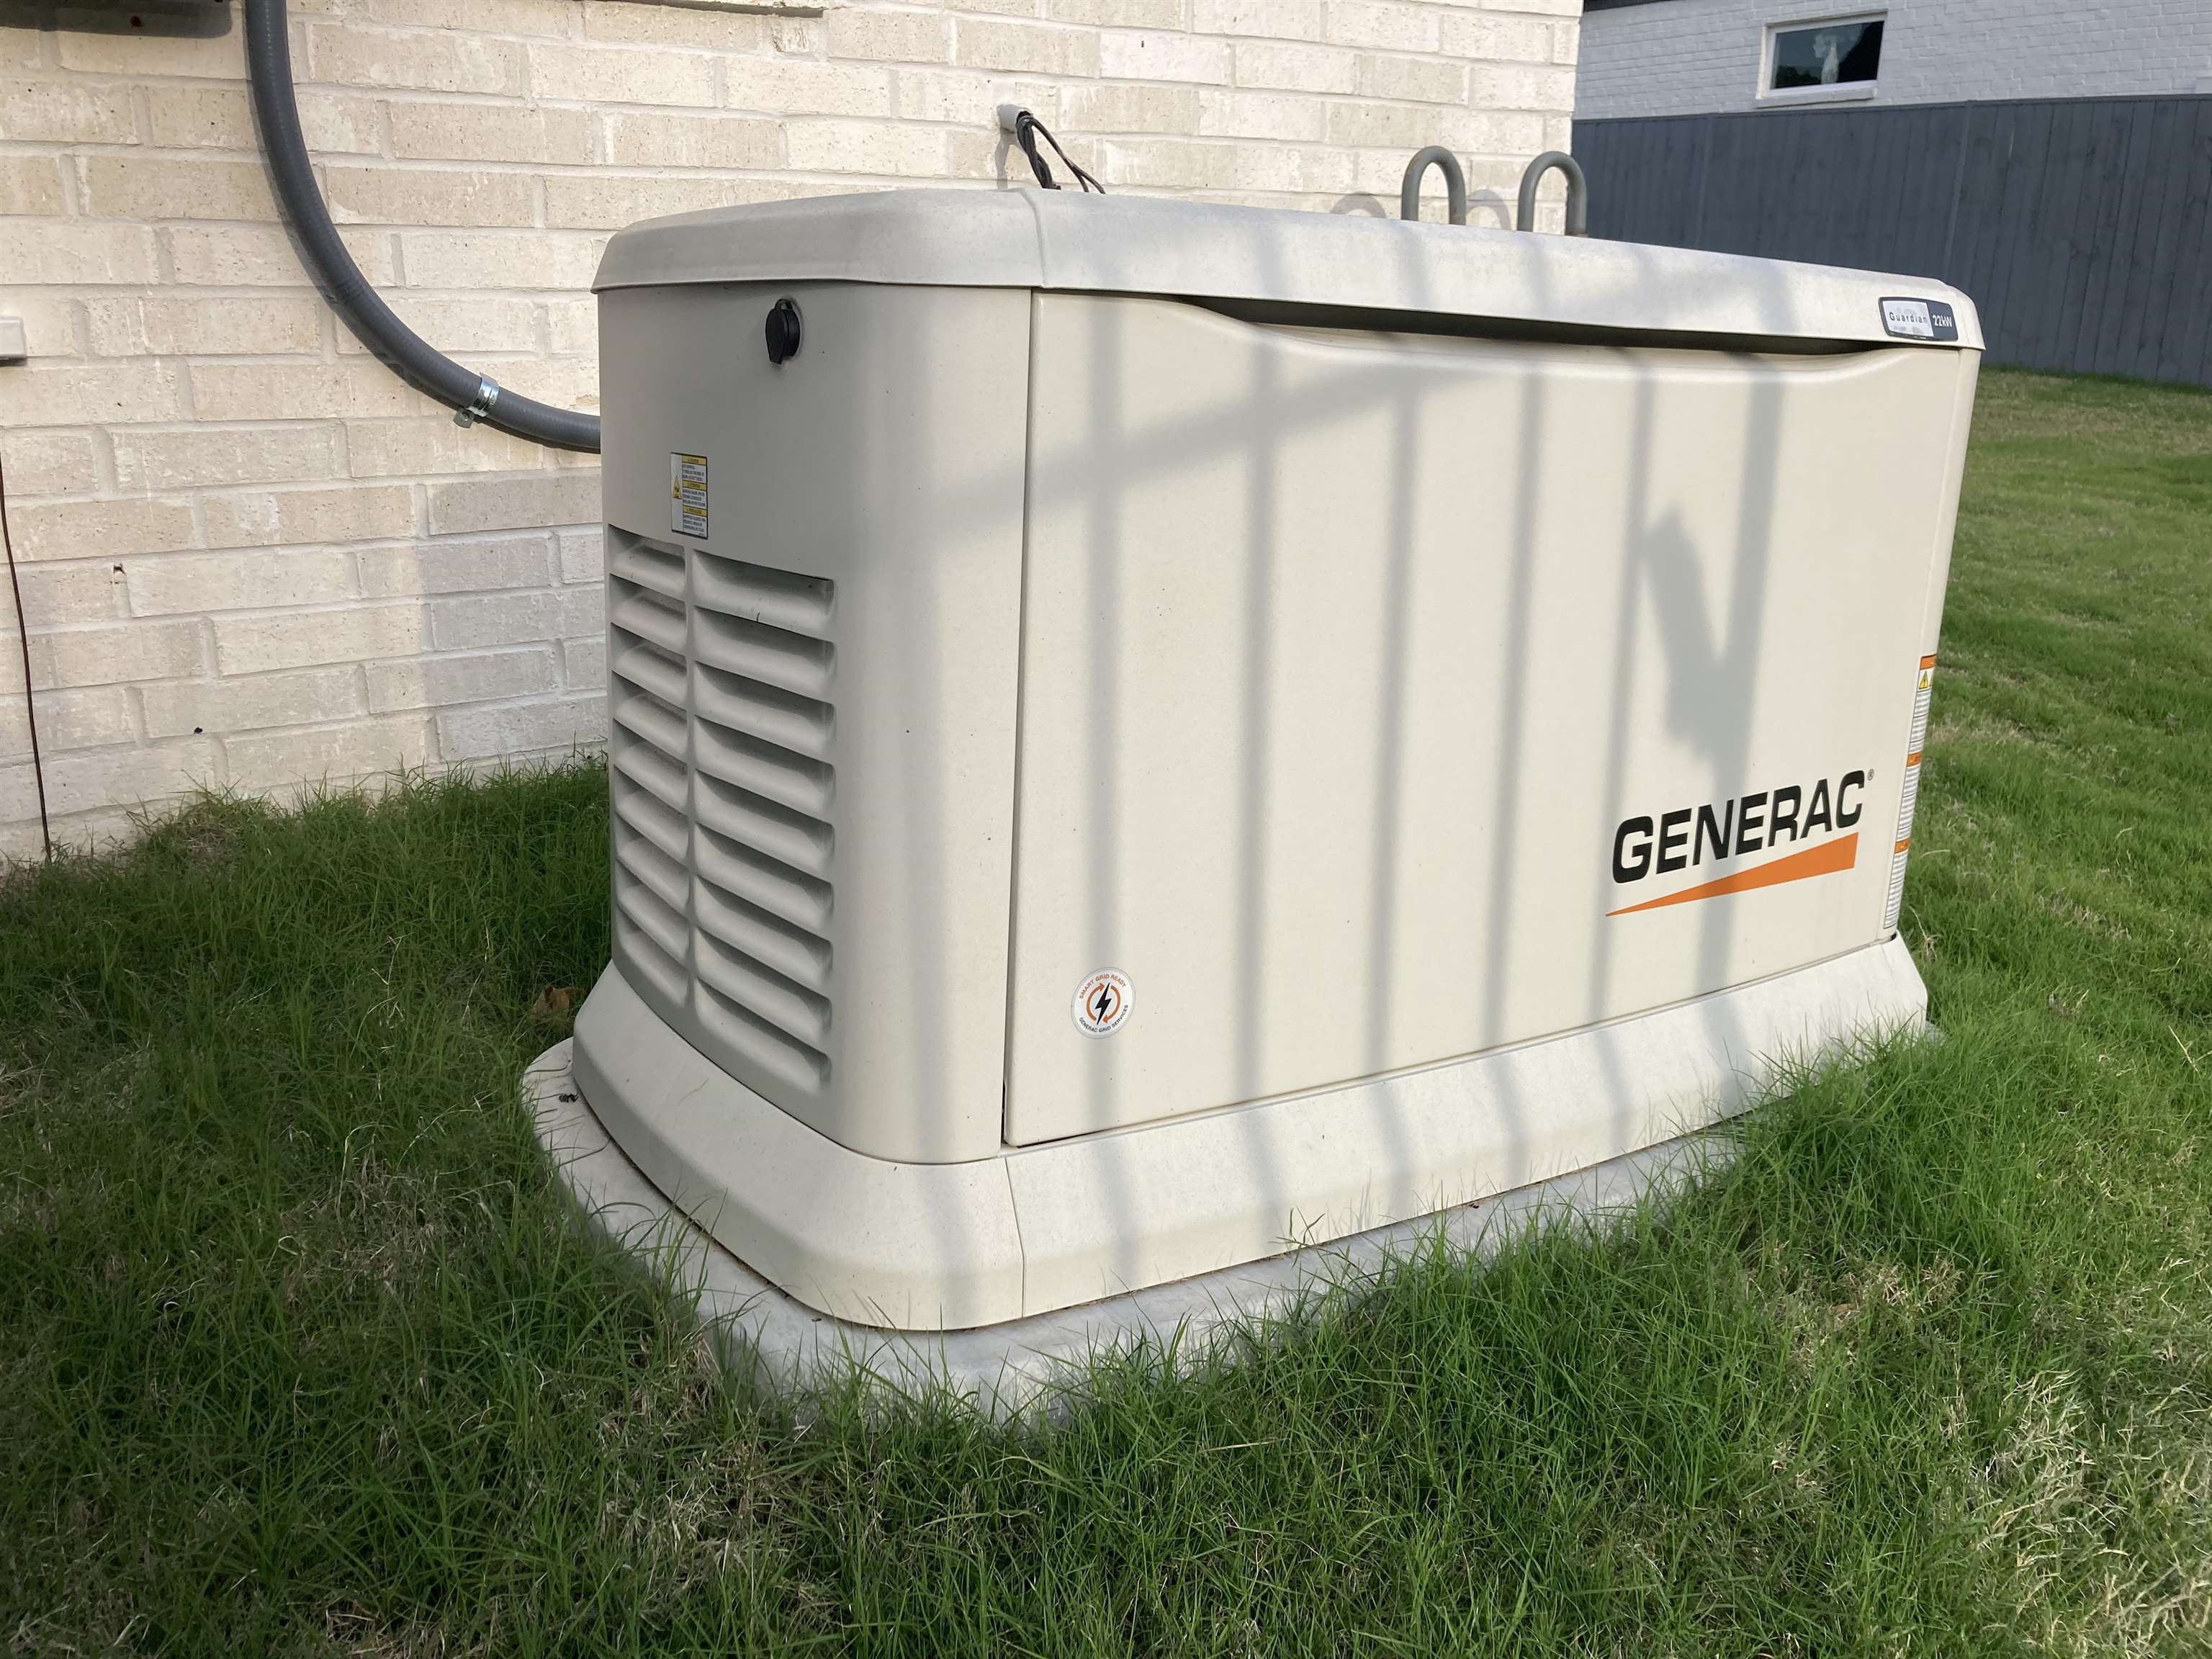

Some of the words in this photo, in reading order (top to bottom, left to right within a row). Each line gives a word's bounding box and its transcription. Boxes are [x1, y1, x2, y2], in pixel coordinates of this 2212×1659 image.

[1889, 312, 1928, 323] Guardian
[1932, 314, 1953, 328] 22kW
[1612, 770, 1865, 884] GENERAC
[1079, 979, 1094, 999] SMART
[1110, 974, 1126, 987] READY
[1079, 1017, 1098, 1033] GENERAC
[1112, 1004, 1128, 1028] SERVICES
